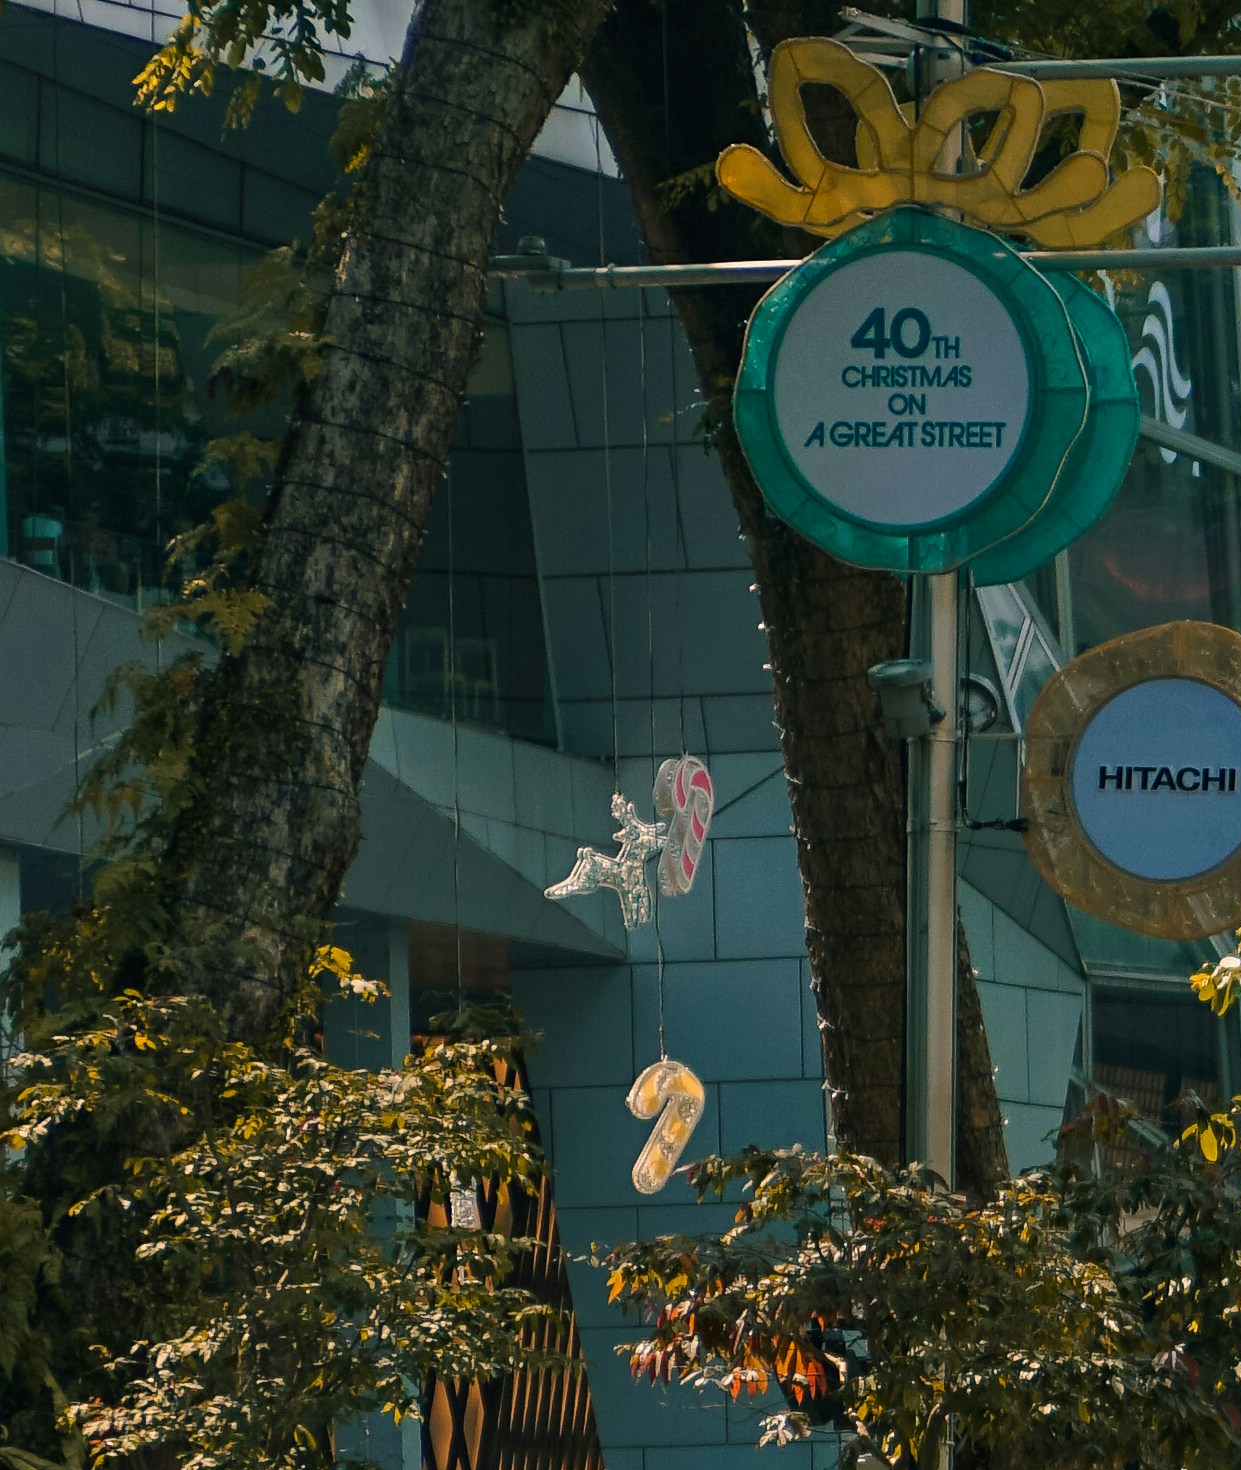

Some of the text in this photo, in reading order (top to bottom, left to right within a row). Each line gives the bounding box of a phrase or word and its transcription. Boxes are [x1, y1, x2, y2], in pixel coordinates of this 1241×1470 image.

[841, 365, 972, 389] CHRISTMAS
[887, 393, 926, 415] ON
[804, 422, 1006, 448] A GREAT STREET
[1098, 765, 1238, 793] HITACHI
